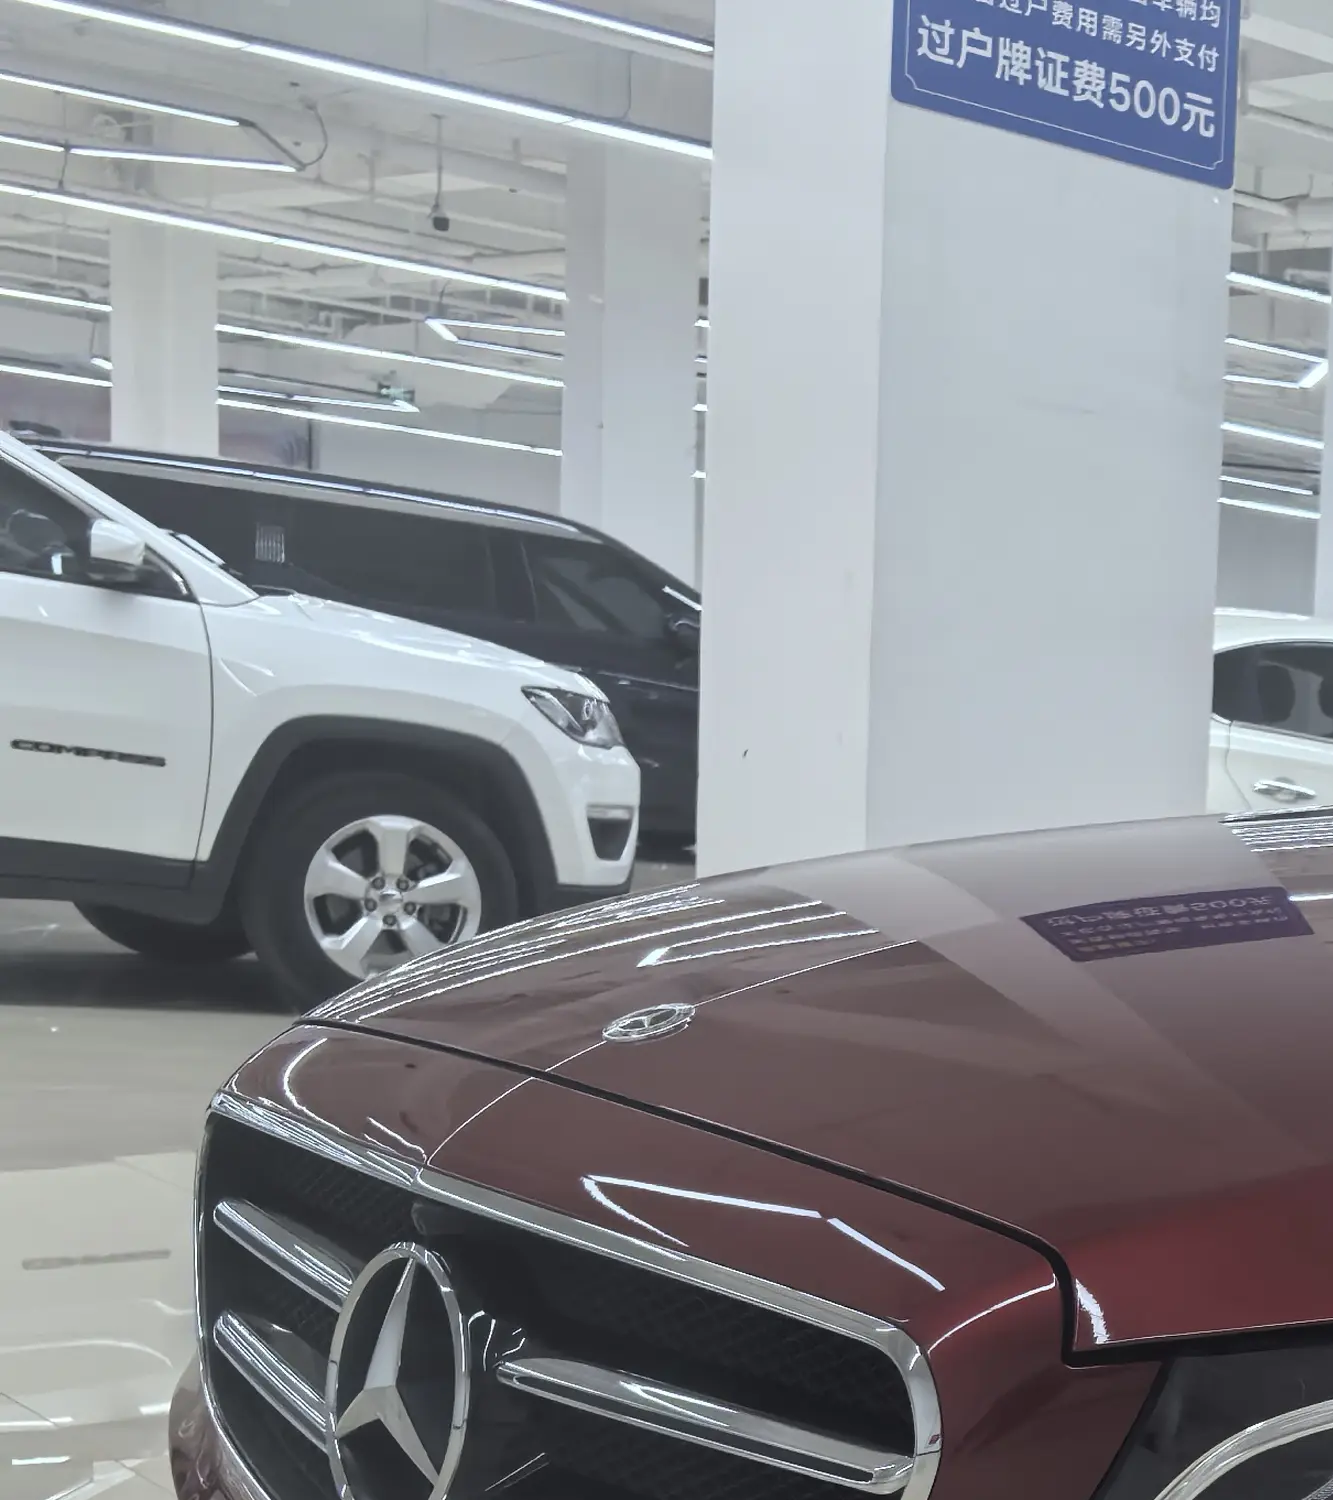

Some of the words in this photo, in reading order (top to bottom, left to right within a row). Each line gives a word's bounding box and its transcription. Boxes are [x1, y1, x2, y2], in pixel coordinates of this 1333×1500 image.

[917, 15, 1215, 138] 过户牌证费500元
[975, 0, 1220, 72] 过户费用需另外支付
